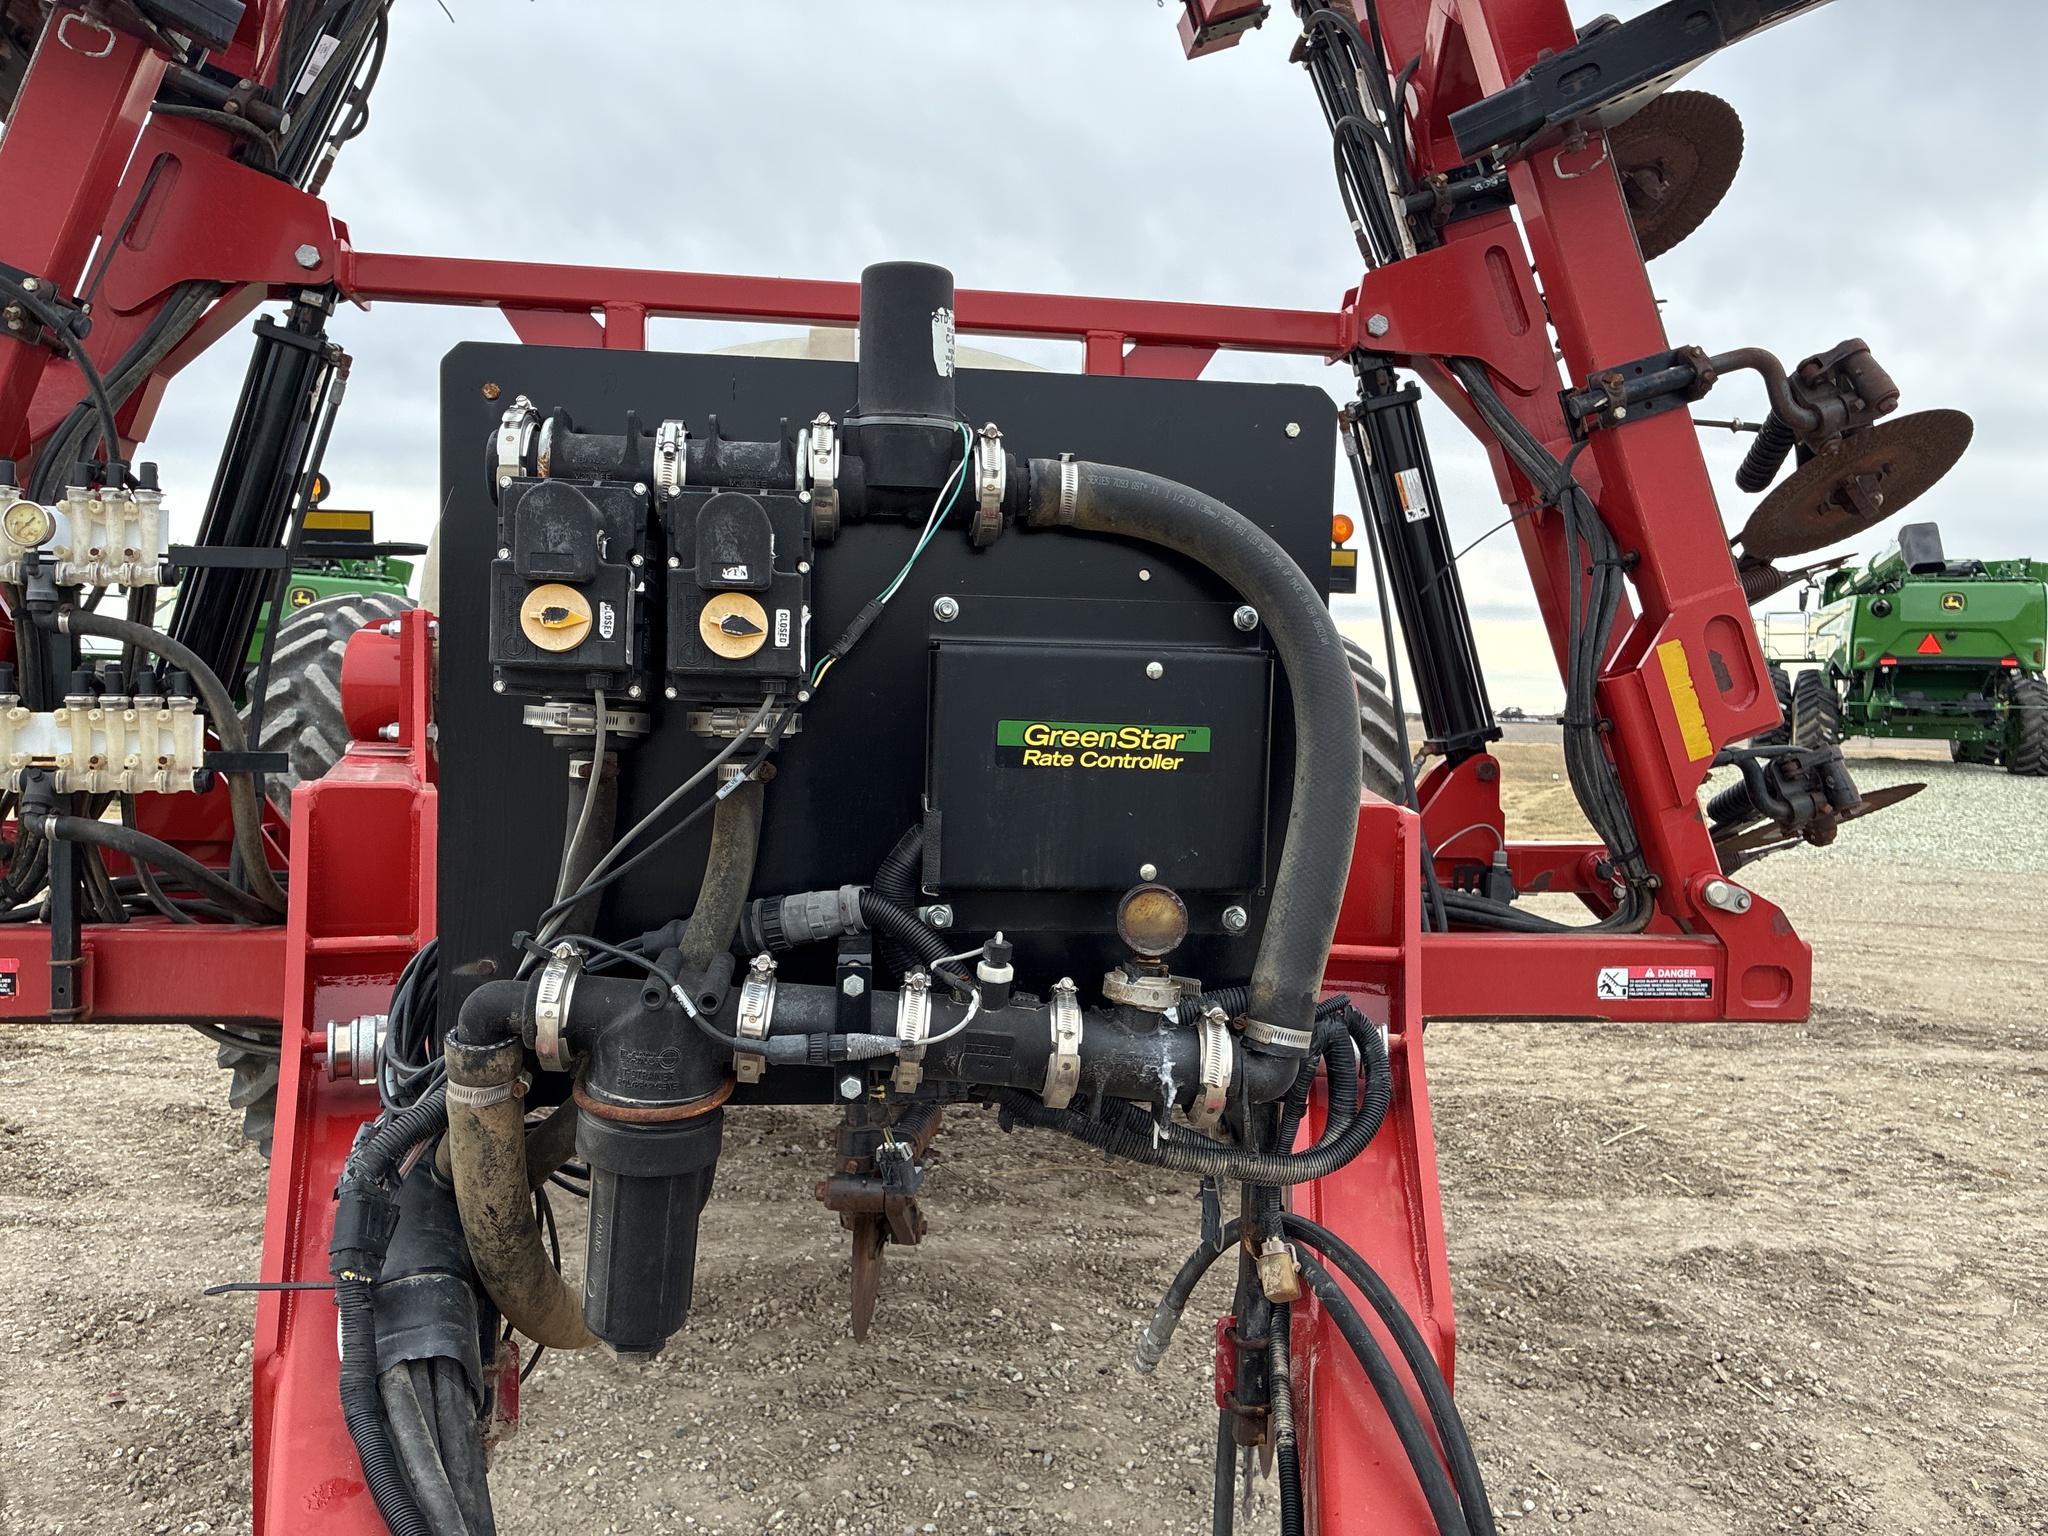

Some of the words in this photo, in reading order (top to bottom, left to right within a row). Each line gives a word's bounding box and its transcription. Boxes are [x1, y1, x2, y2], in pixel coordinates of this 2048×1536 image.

[1086, 475, 1110, 486] SERIES
[1113, 477, 1129, 489] 7093
[1172, 490, 1184, 504] 1/2
[1221, 515, 1234, 530] 200
[1233, 523, 1248, 537] PSI
[1306, 603, 1318, 618] USA
[603, 603, 613, 636] CLOSED
[779, 612, 789, 644] CLOSED
[1023, 723, 1185, 750] GreenStar
[1022, 749, 1075, 767] Rate
[1079, 750, 1184, 770] Controller
[721, 777, 739, 793] VALVE
[1657, 969, 1697, 978] DANGER
[622, 1067, 675, 1081] T-STRAINER
